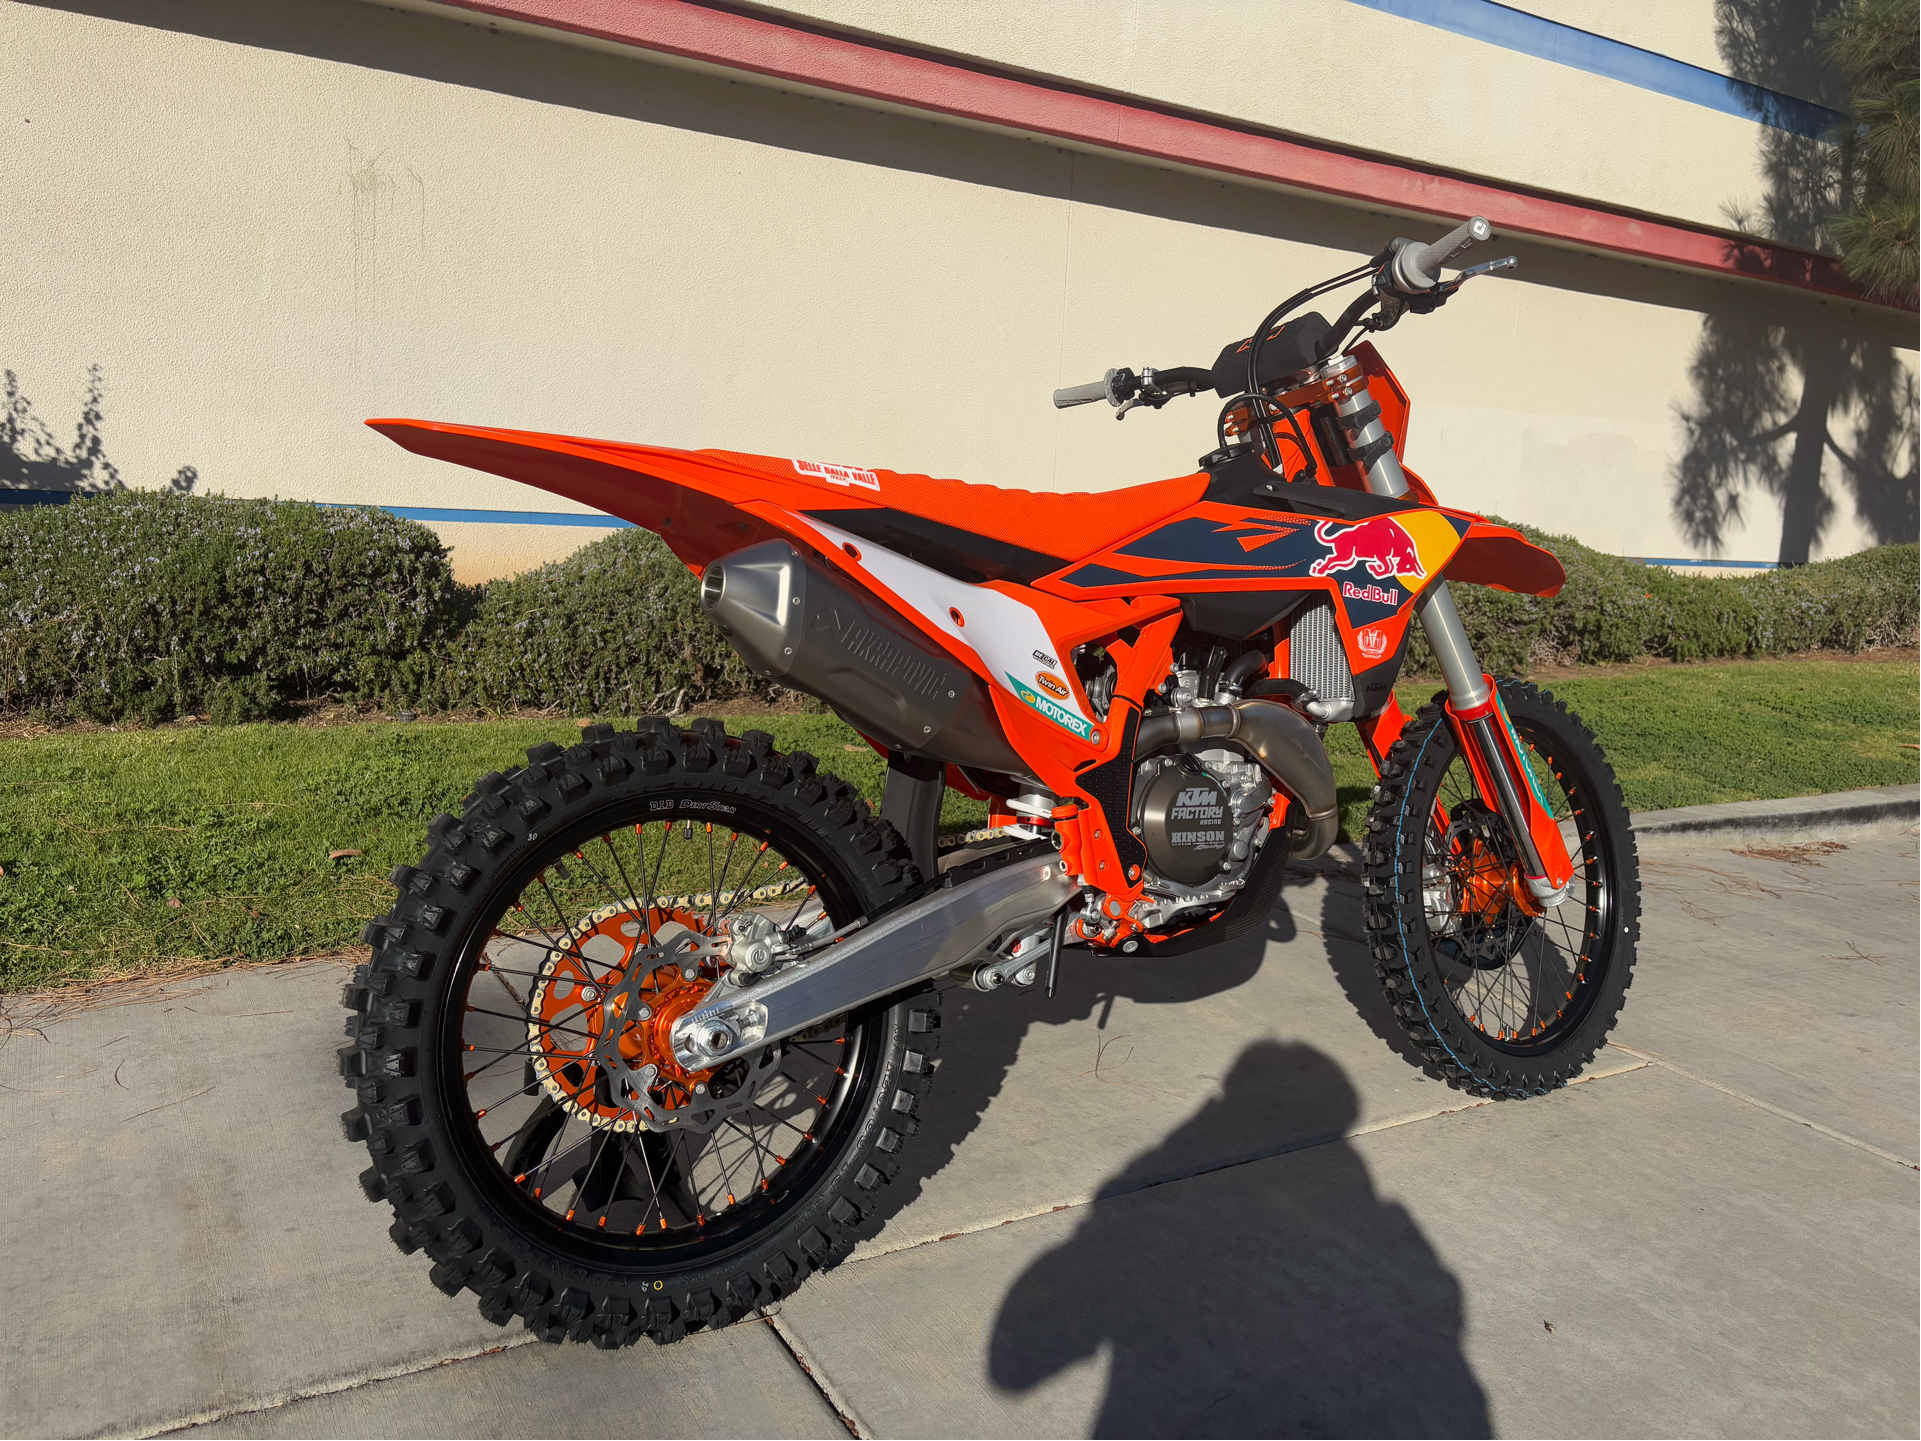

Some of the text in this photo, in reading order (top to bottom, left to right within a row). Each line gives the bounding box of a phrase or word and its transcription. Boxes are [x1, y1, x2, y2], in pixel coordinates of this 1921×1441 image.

[852, 471, 877, 486] VALLE
[1038, 674, 1069, 697] Twin Air
[1366, 682, 1388, 692] KTM
[1036, 696, 1088, 736] MOTOREX
[1176, 787, 1218, 806] KTM
[1171, 806, 1224, 820] FACTORY
[1171, 830, 1225, 843] HINSON
